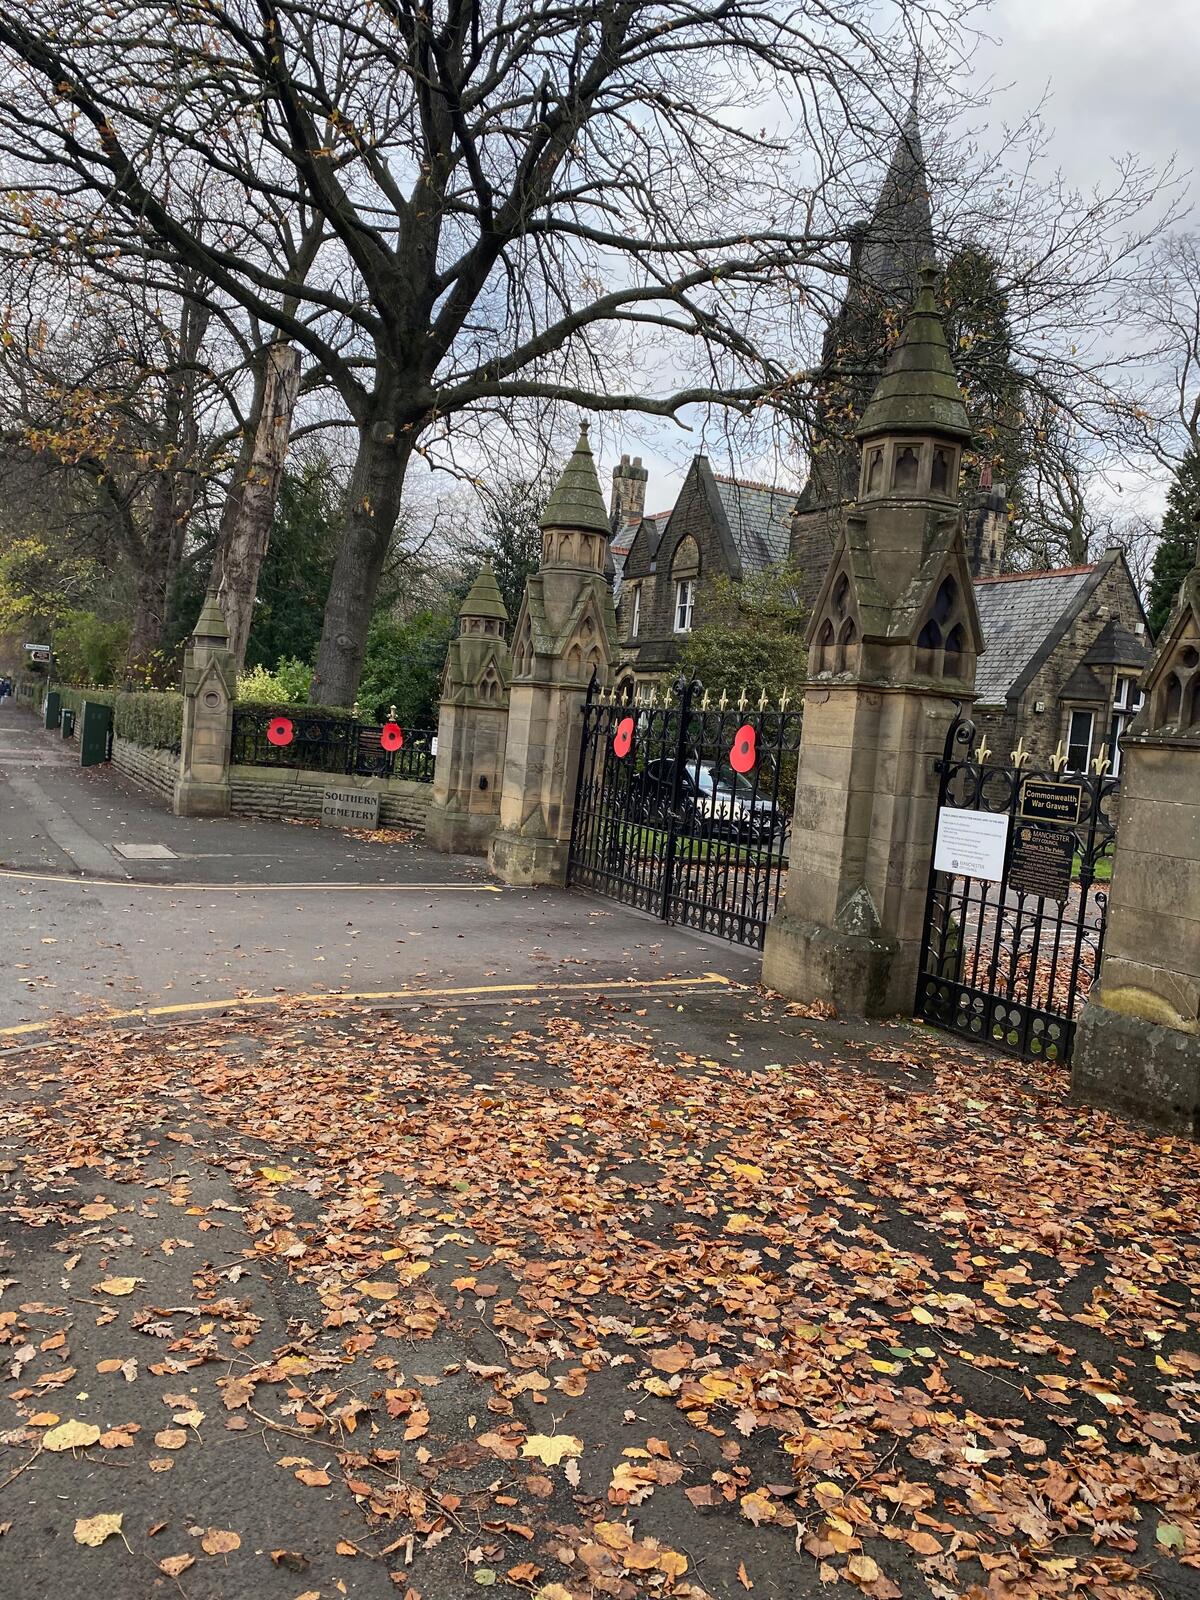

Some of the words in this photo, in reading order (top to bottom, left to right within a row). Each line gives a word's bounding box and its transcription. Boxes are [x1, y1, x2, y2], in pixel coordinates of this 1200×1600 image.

[324, 791, 377, 805] SOUTHERN
[1026, 789, 1077, 802] Commonwealth
[1032, 799, 1045, 808] War
[1045, 801, 1069, 811] Graves
[324, 807, 375, 820] CEMETERY
[1032, 830, 1070, 843] MANCHESTER
[1040, 838, 1059, 846] COUNCIL
